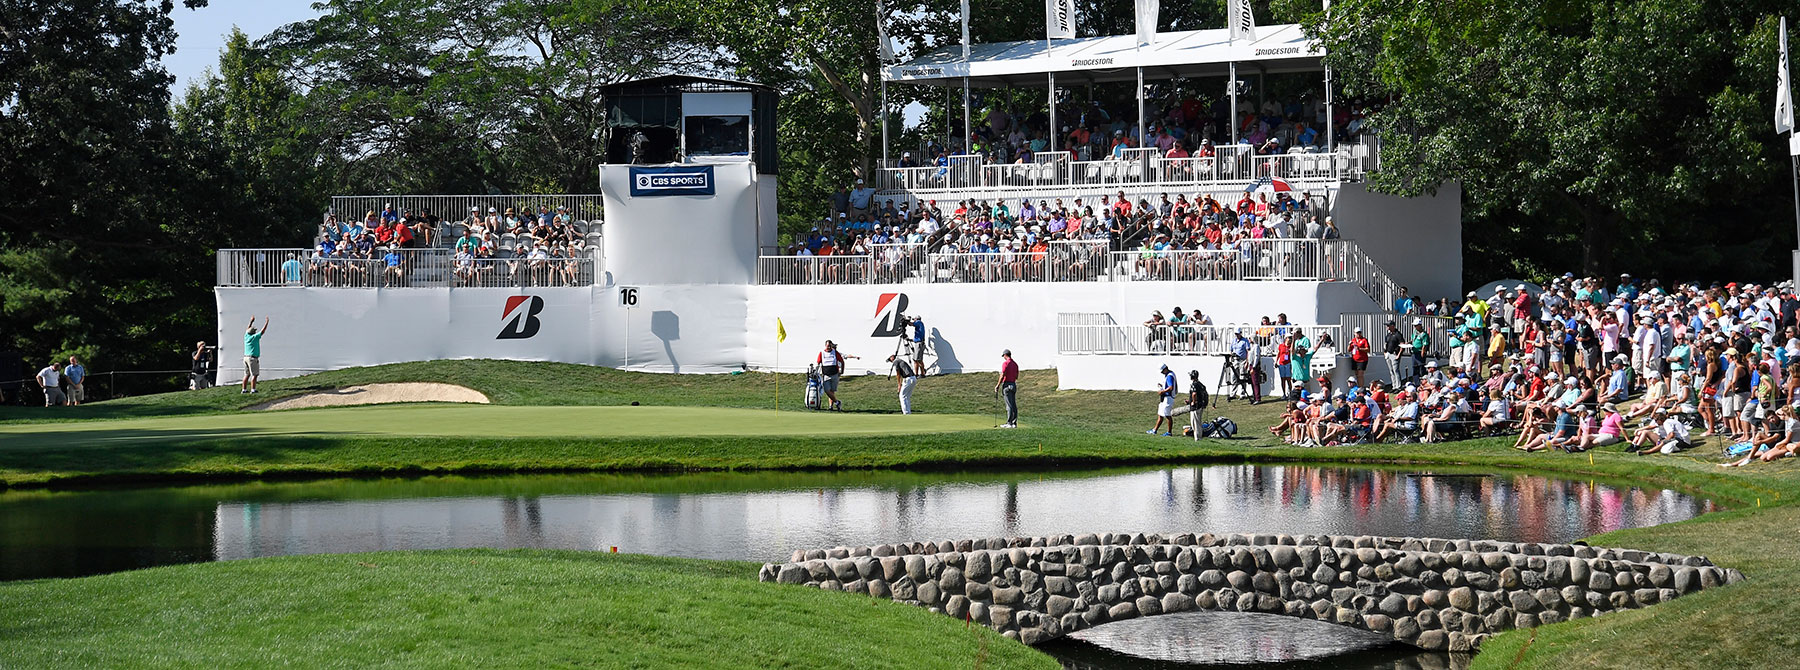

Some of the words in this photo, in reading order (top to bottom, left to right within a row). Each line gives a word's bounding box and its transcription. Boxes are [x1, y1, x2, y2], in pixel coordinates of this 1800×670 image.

[1255, 47, 1300, 56] BRIDGESTONE
[1072, 57, 1114, 66] BRIDGESTONE
[902, 67, 943, 77] BRIDGESTONE
[652, 177, 669, 185] CBS
[670, 176, 704, 185] SPORTS
[620, 288, 638, 306] 16
